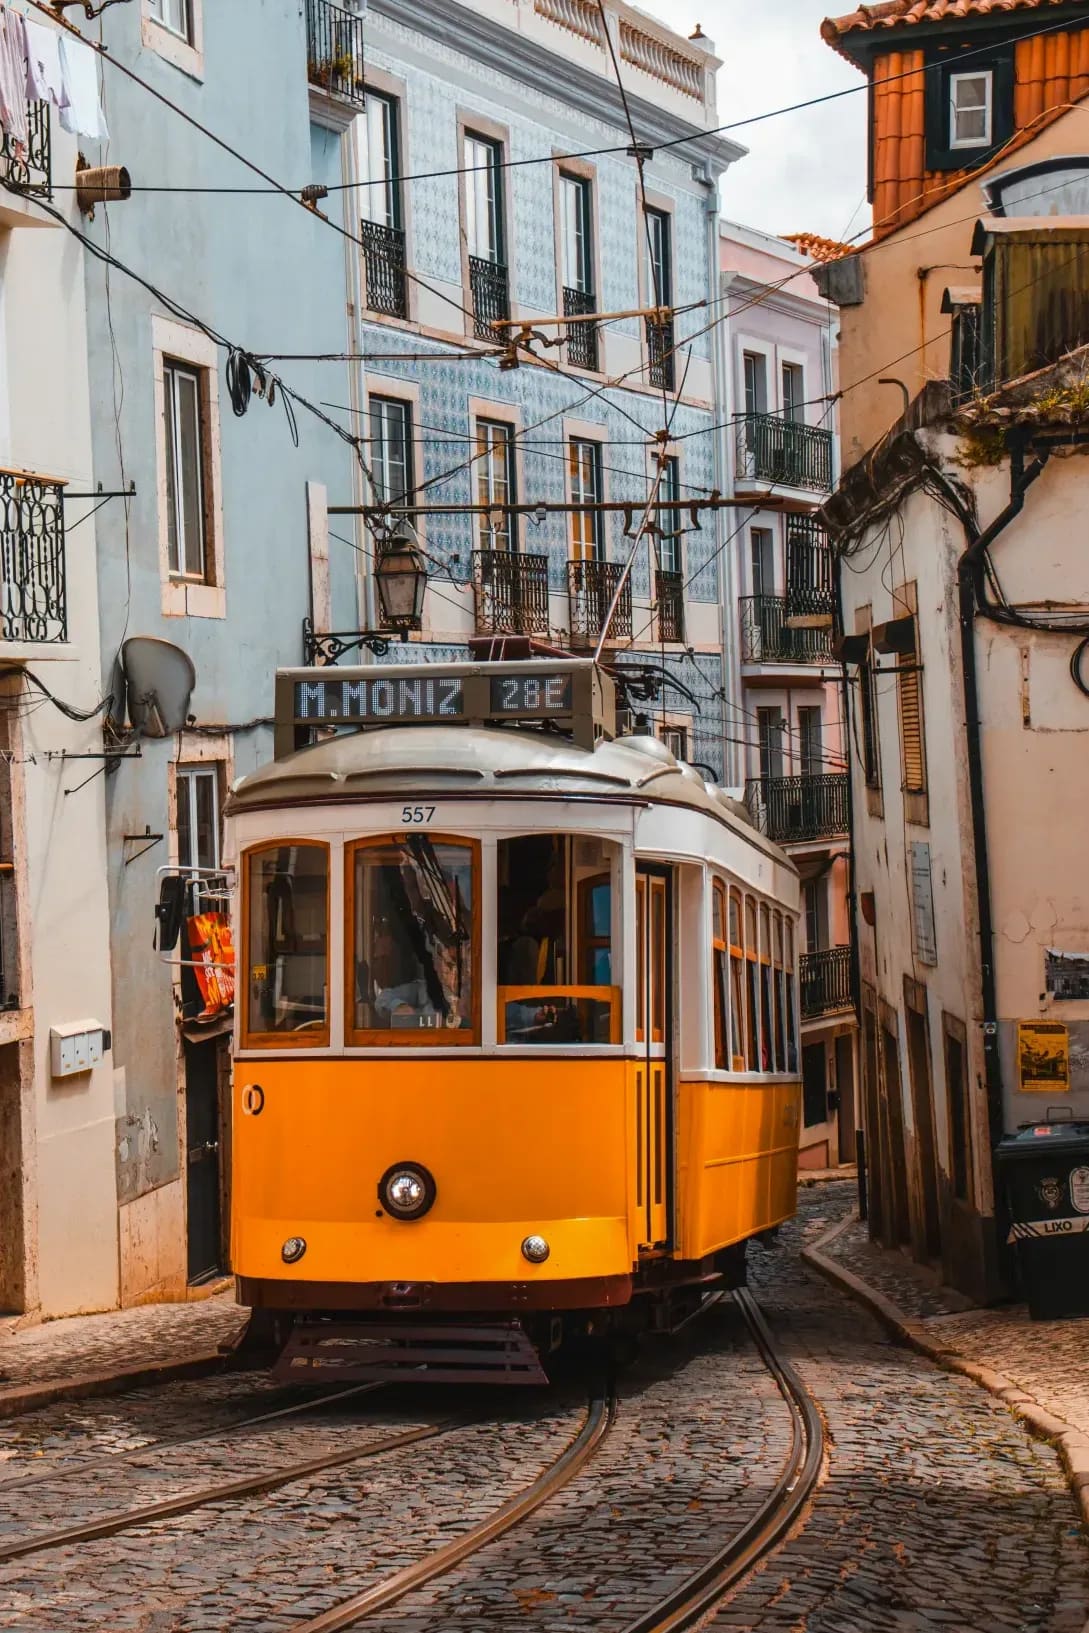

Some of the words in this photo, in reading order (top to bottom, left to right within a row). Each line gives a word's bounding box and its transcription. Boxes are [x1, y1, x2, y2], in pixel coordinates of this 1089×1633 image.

[300, 679, 463, 717] M.MONIZ
[502, 679, 564, 709] 28E
[401, 806, 436, 822] 557
[1044, 1220, 1072, 1232] LIXO
